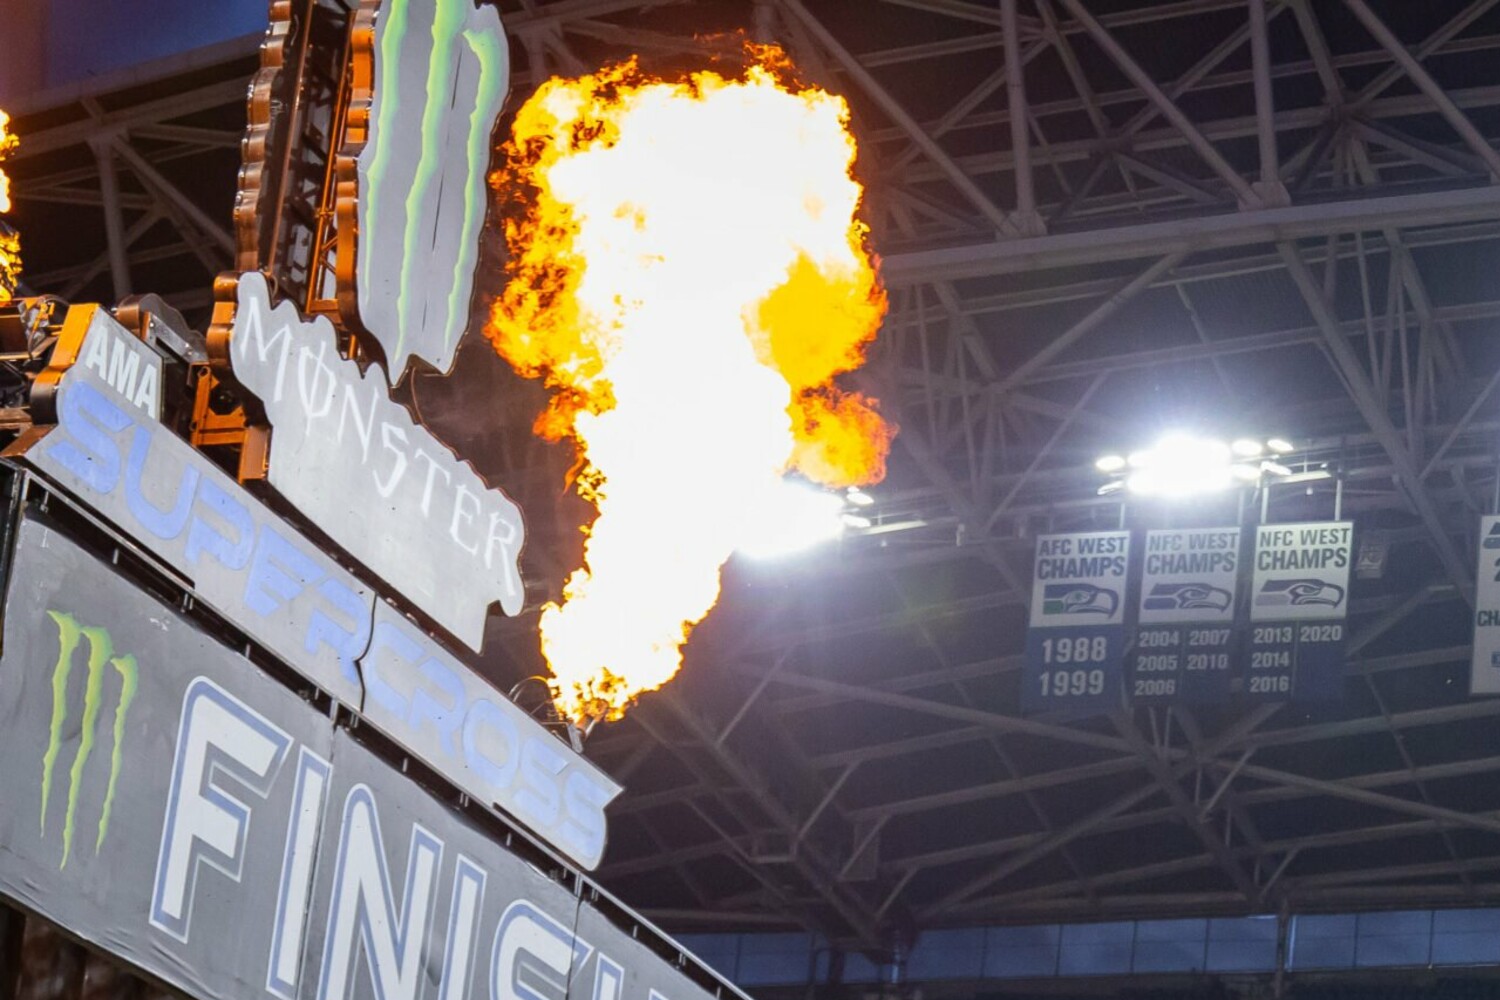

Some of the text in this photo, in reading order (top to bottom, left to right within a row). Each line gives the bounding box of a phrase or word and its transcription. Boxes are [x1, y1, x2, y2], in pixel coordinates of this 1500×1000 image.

[84, 326, 159, 419] AMA
[1038, 537, 1126, 556] AFC WEST
[1149, 532, 1238, 552] NFC WEST
[1259, 527, 1350, 547] NFC WEST
[1038, 556, 1125, 579] CHAMPS
[1146, 551, 1235, 575] CHAMPS
[1258, 547, 1348, 571] CHAMPS
[47, 380, 606, 863] SUPERCROSS
[1139, 629, 1230, 647] 2004 2007
[1253, 625, 1342, 643] 2013 2020
[1042, 636, 1107, 663] 1988
[1252, 651, 1290, 668] 2014
[1039, 669, 1104, 696] 1999
[1250, 676, 1289, 693] 2016
